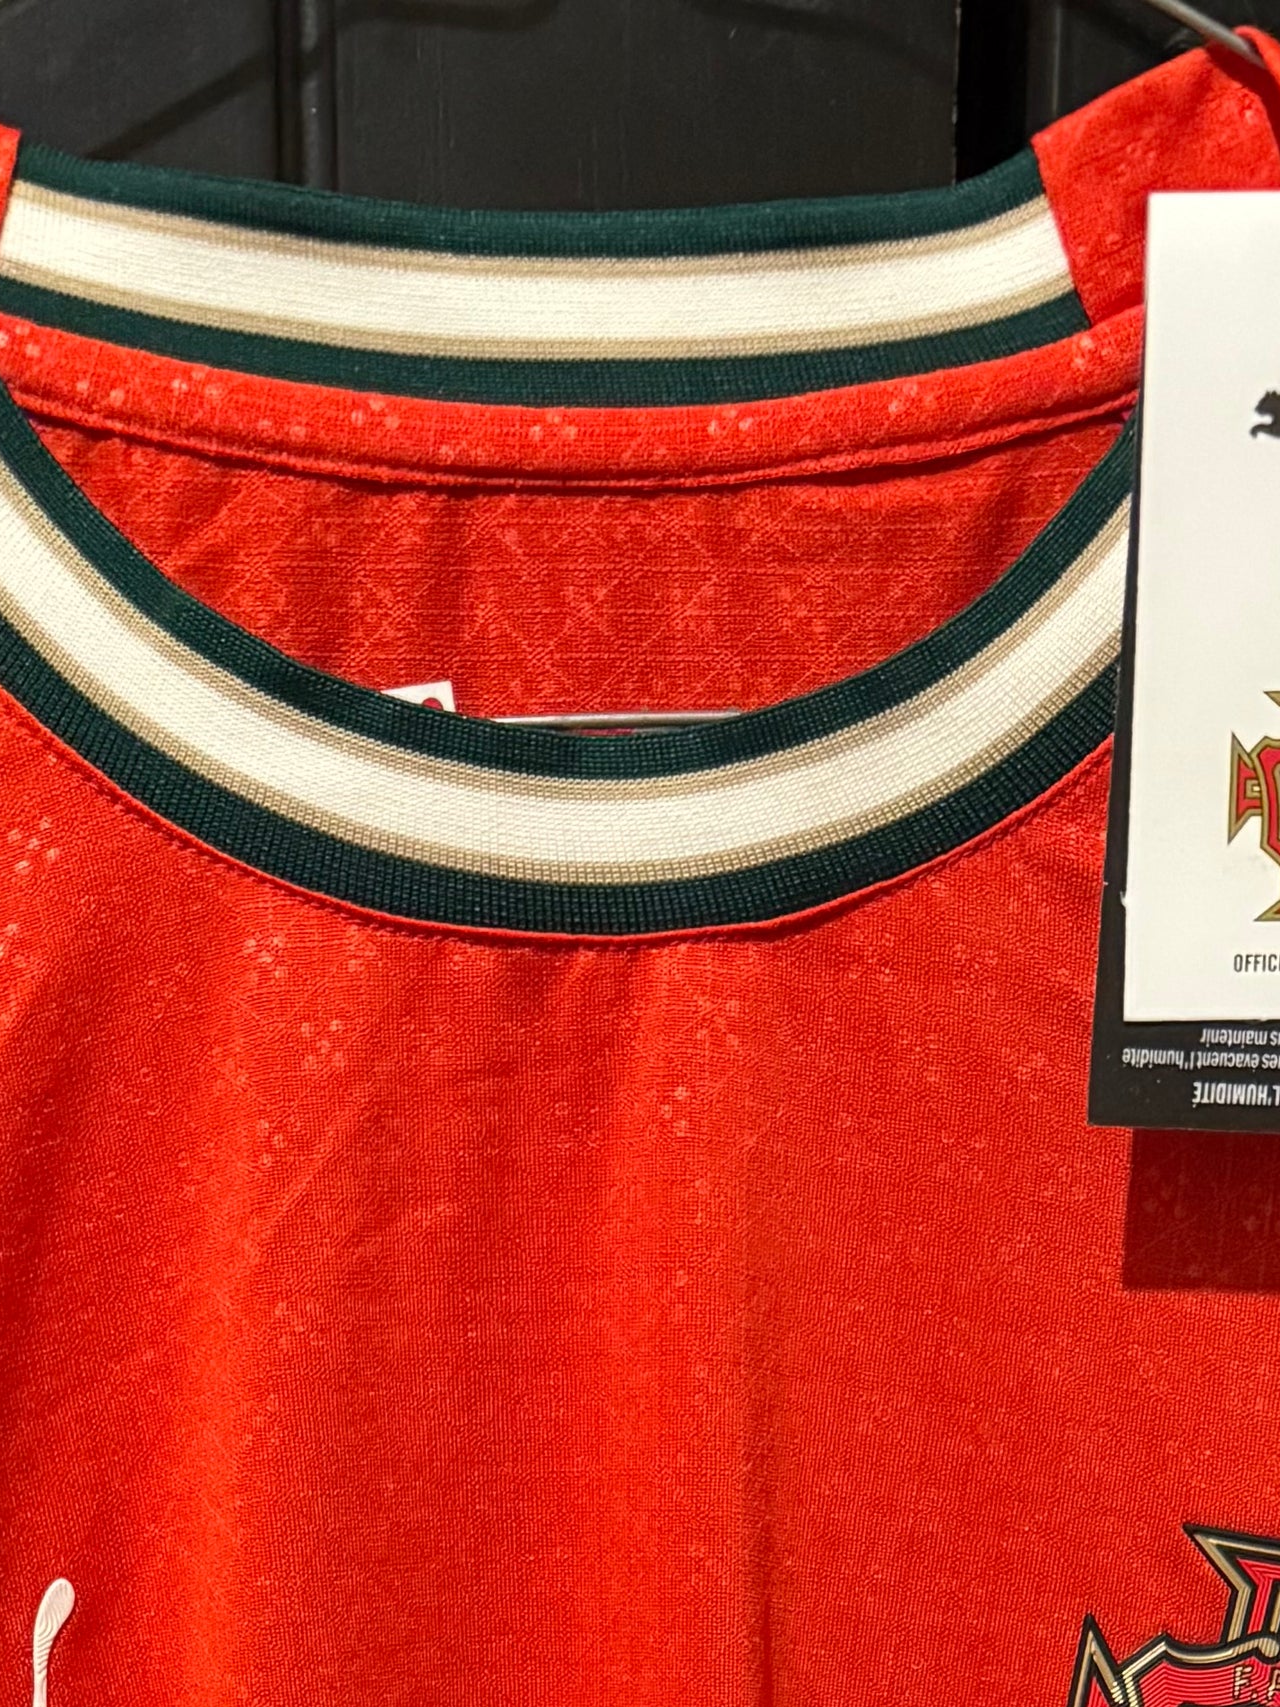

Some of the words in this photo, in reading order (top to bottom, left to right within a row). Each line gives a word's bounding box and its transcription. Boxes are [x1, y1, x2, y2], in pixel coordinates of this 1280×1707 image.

[1200, 1027, 1268, 1047] maintenir
[1197, 1050, 1259, 1073] évacuent
[1192, 1081, 1280, 1109] L'HUMIDITÉ
